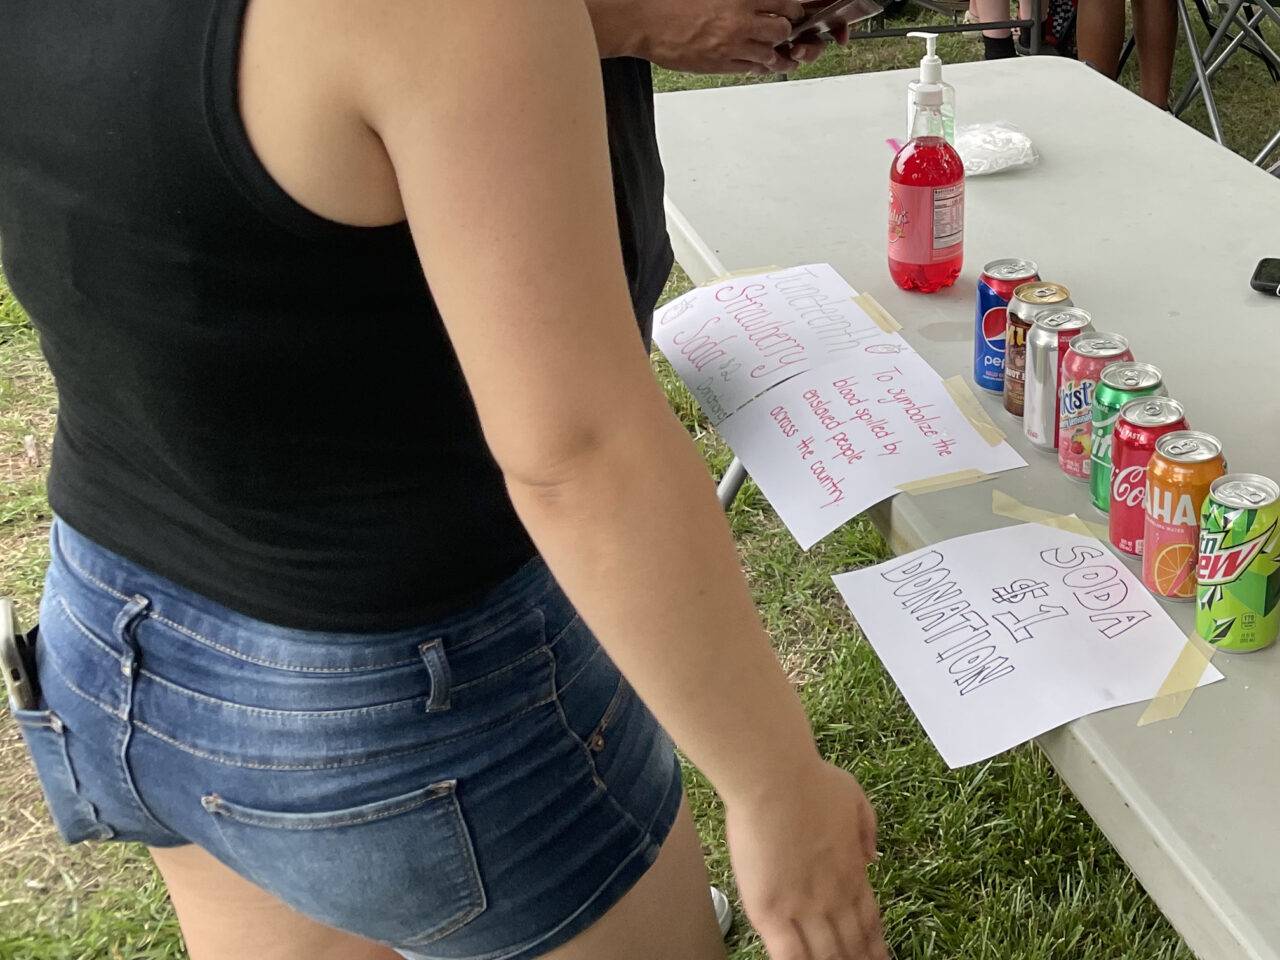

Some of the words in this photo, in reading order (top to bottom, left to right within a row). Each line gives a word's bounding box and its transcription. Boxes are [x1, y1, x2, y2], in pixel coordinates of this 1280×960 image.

[673, 316, 738, 372] Soda
[715, 283, 809, 379] Strawberry
[832, 375, 870, 407] blood
[872, 366, 903, 382] To
[769, 405, 799, 438] across
[796, 435, 815, 460] the
[802, 388, 847, 431] enslaved
[825, 431, 866, 465] people
[849, 407, 895, 440] spilled
[877, 387, 942, 439] symbolize
[877, 440, 903, 456] by
[931, 438, 957, 457] the
[991, 578, 1069, 644] $1
[1040, 545, 1152, 640] SODA
[880, 549, 1016, 697] DONATION
